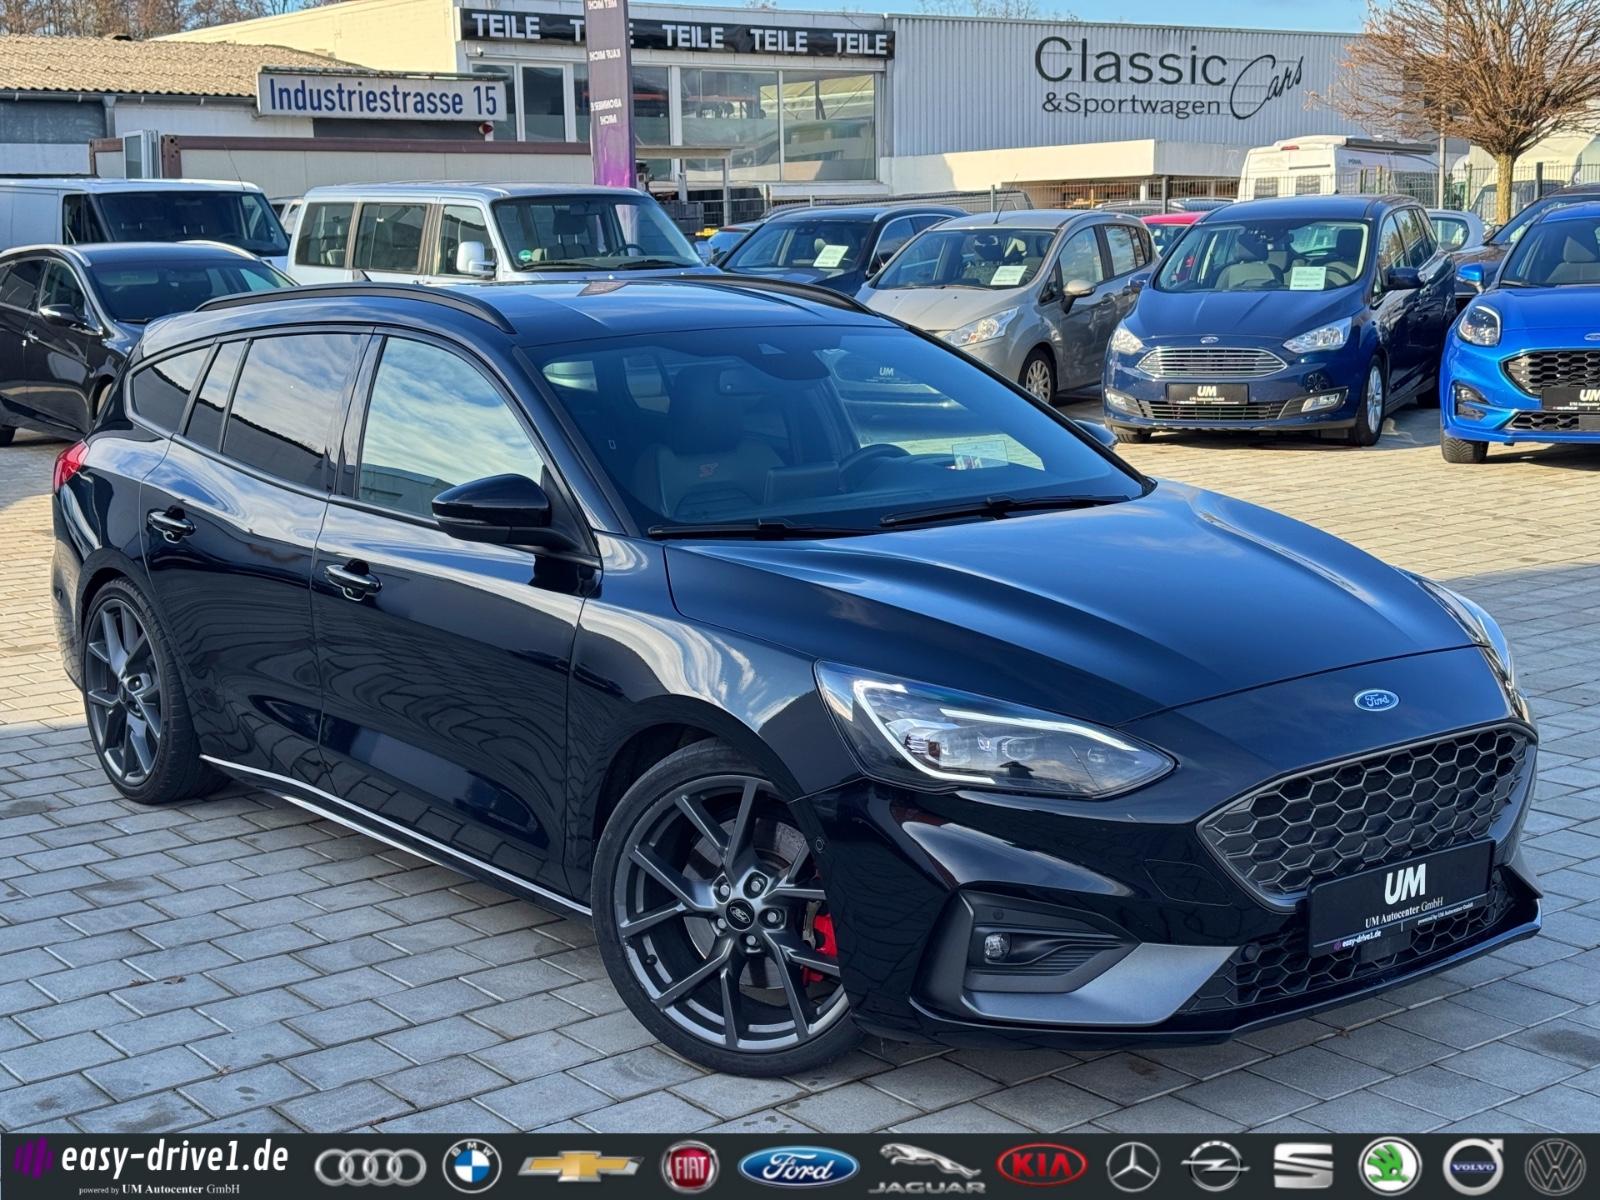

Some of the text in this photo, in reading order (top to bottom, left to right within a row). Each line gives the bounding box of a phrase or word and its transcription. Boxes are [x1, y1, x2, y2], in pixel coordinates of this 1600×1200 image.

[472, 13, 541, 39] TEILE
[662, 24, 724, 48] TEILE
[750, 28, 808, 52] TEILE
[833, 32, 887, 55] TEILE
[1035, 36, 1304, 120] Classic Cars
[269, 78, 497, 116] Industriestrasse 15
[1042, 91, 1220, 119] &Sportwagen
[879, 367, 894, 376] UM
[1197, 385, 1217, 397] UM
[1384, 863, 1426, 905] UM
[1365, 896, 1444, 929] UM Autocenter GmbH
